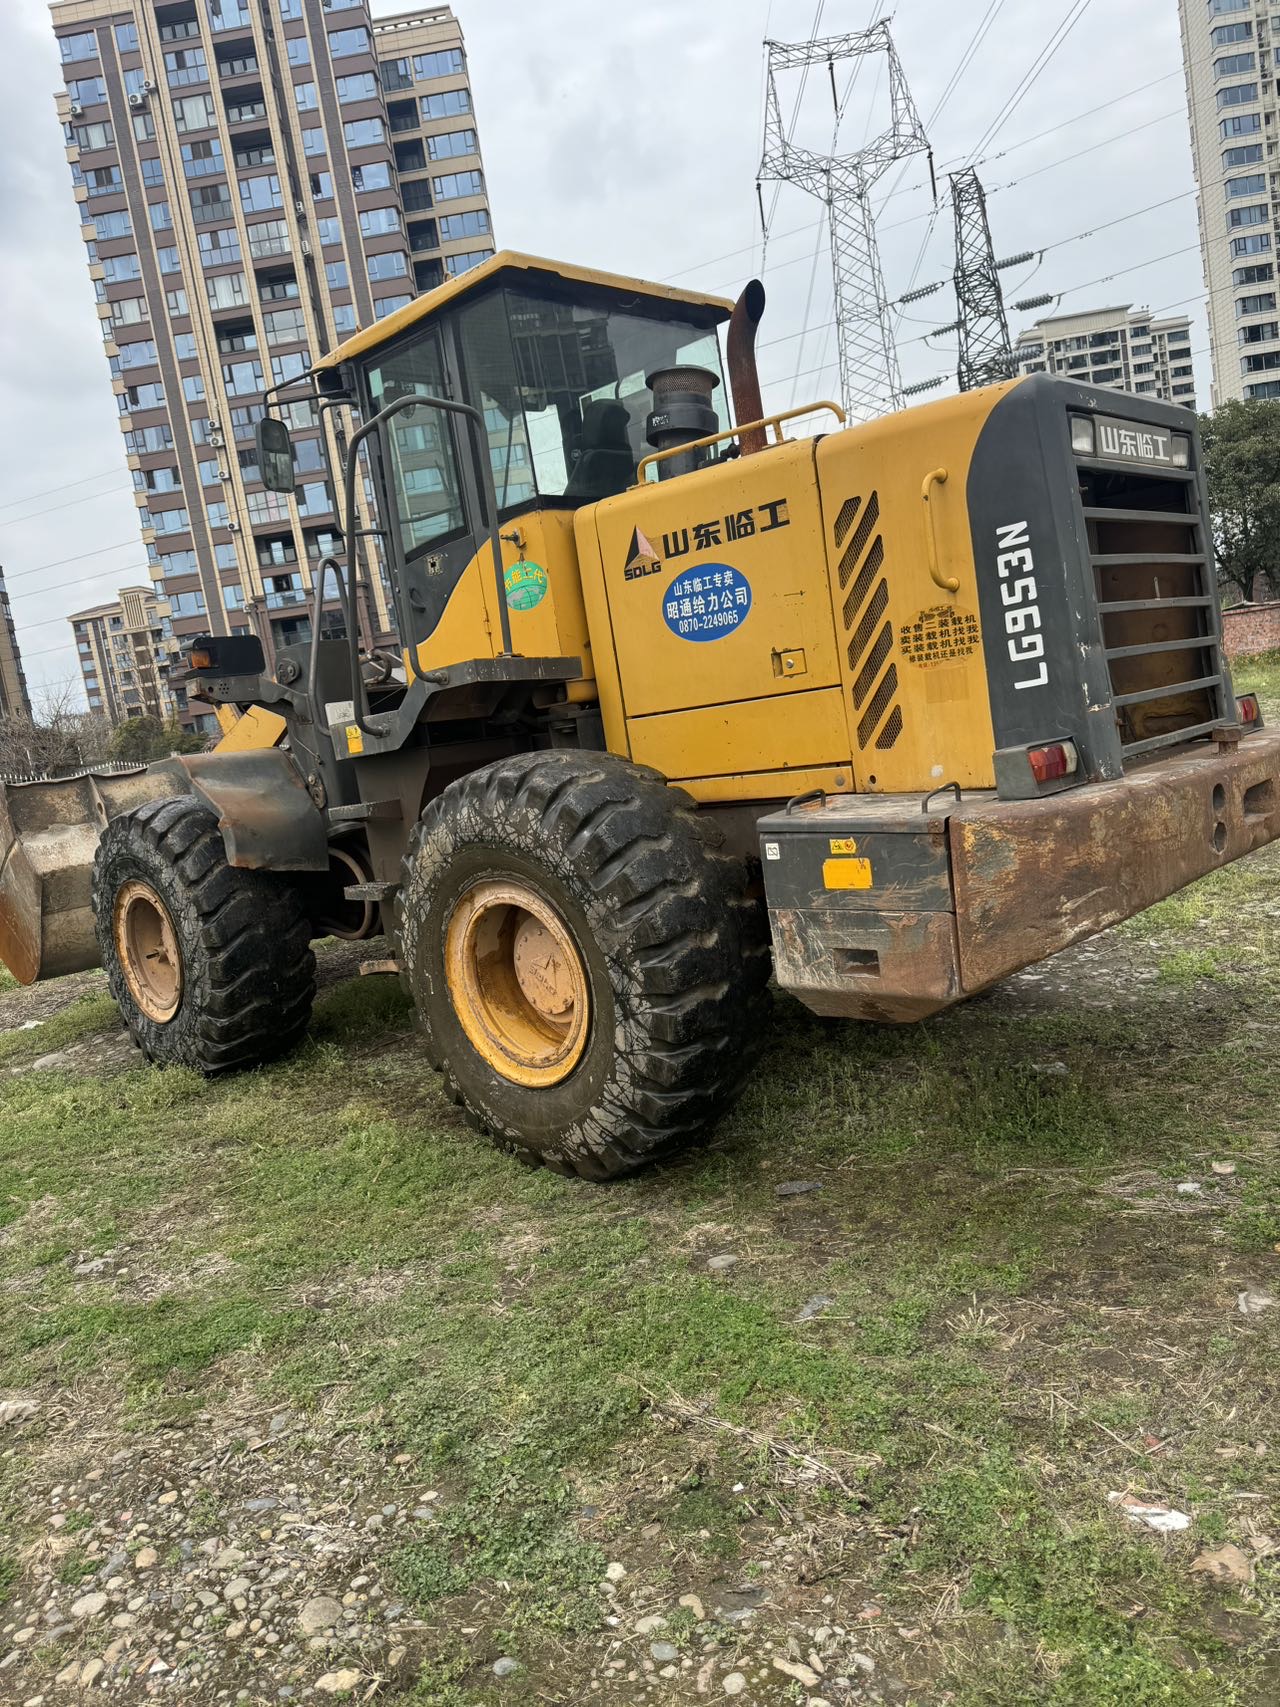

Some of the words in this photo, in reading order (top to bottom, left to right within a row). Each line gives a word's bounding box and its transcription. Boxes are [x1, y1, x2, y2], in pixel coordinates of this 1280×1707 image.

[1099, 425, 1170, 462] 山东临工
[662, 498, 790, 559] 山东临工
[624, 561, 662, 581] SDLG
[673, 570, 734, 597] 山东临工专卖
[666, 587, 748, 620] 昭通给力公司
[996, 520, 1049, 690] LG953N
[679, 609, 739, 634] 0870-2249065
